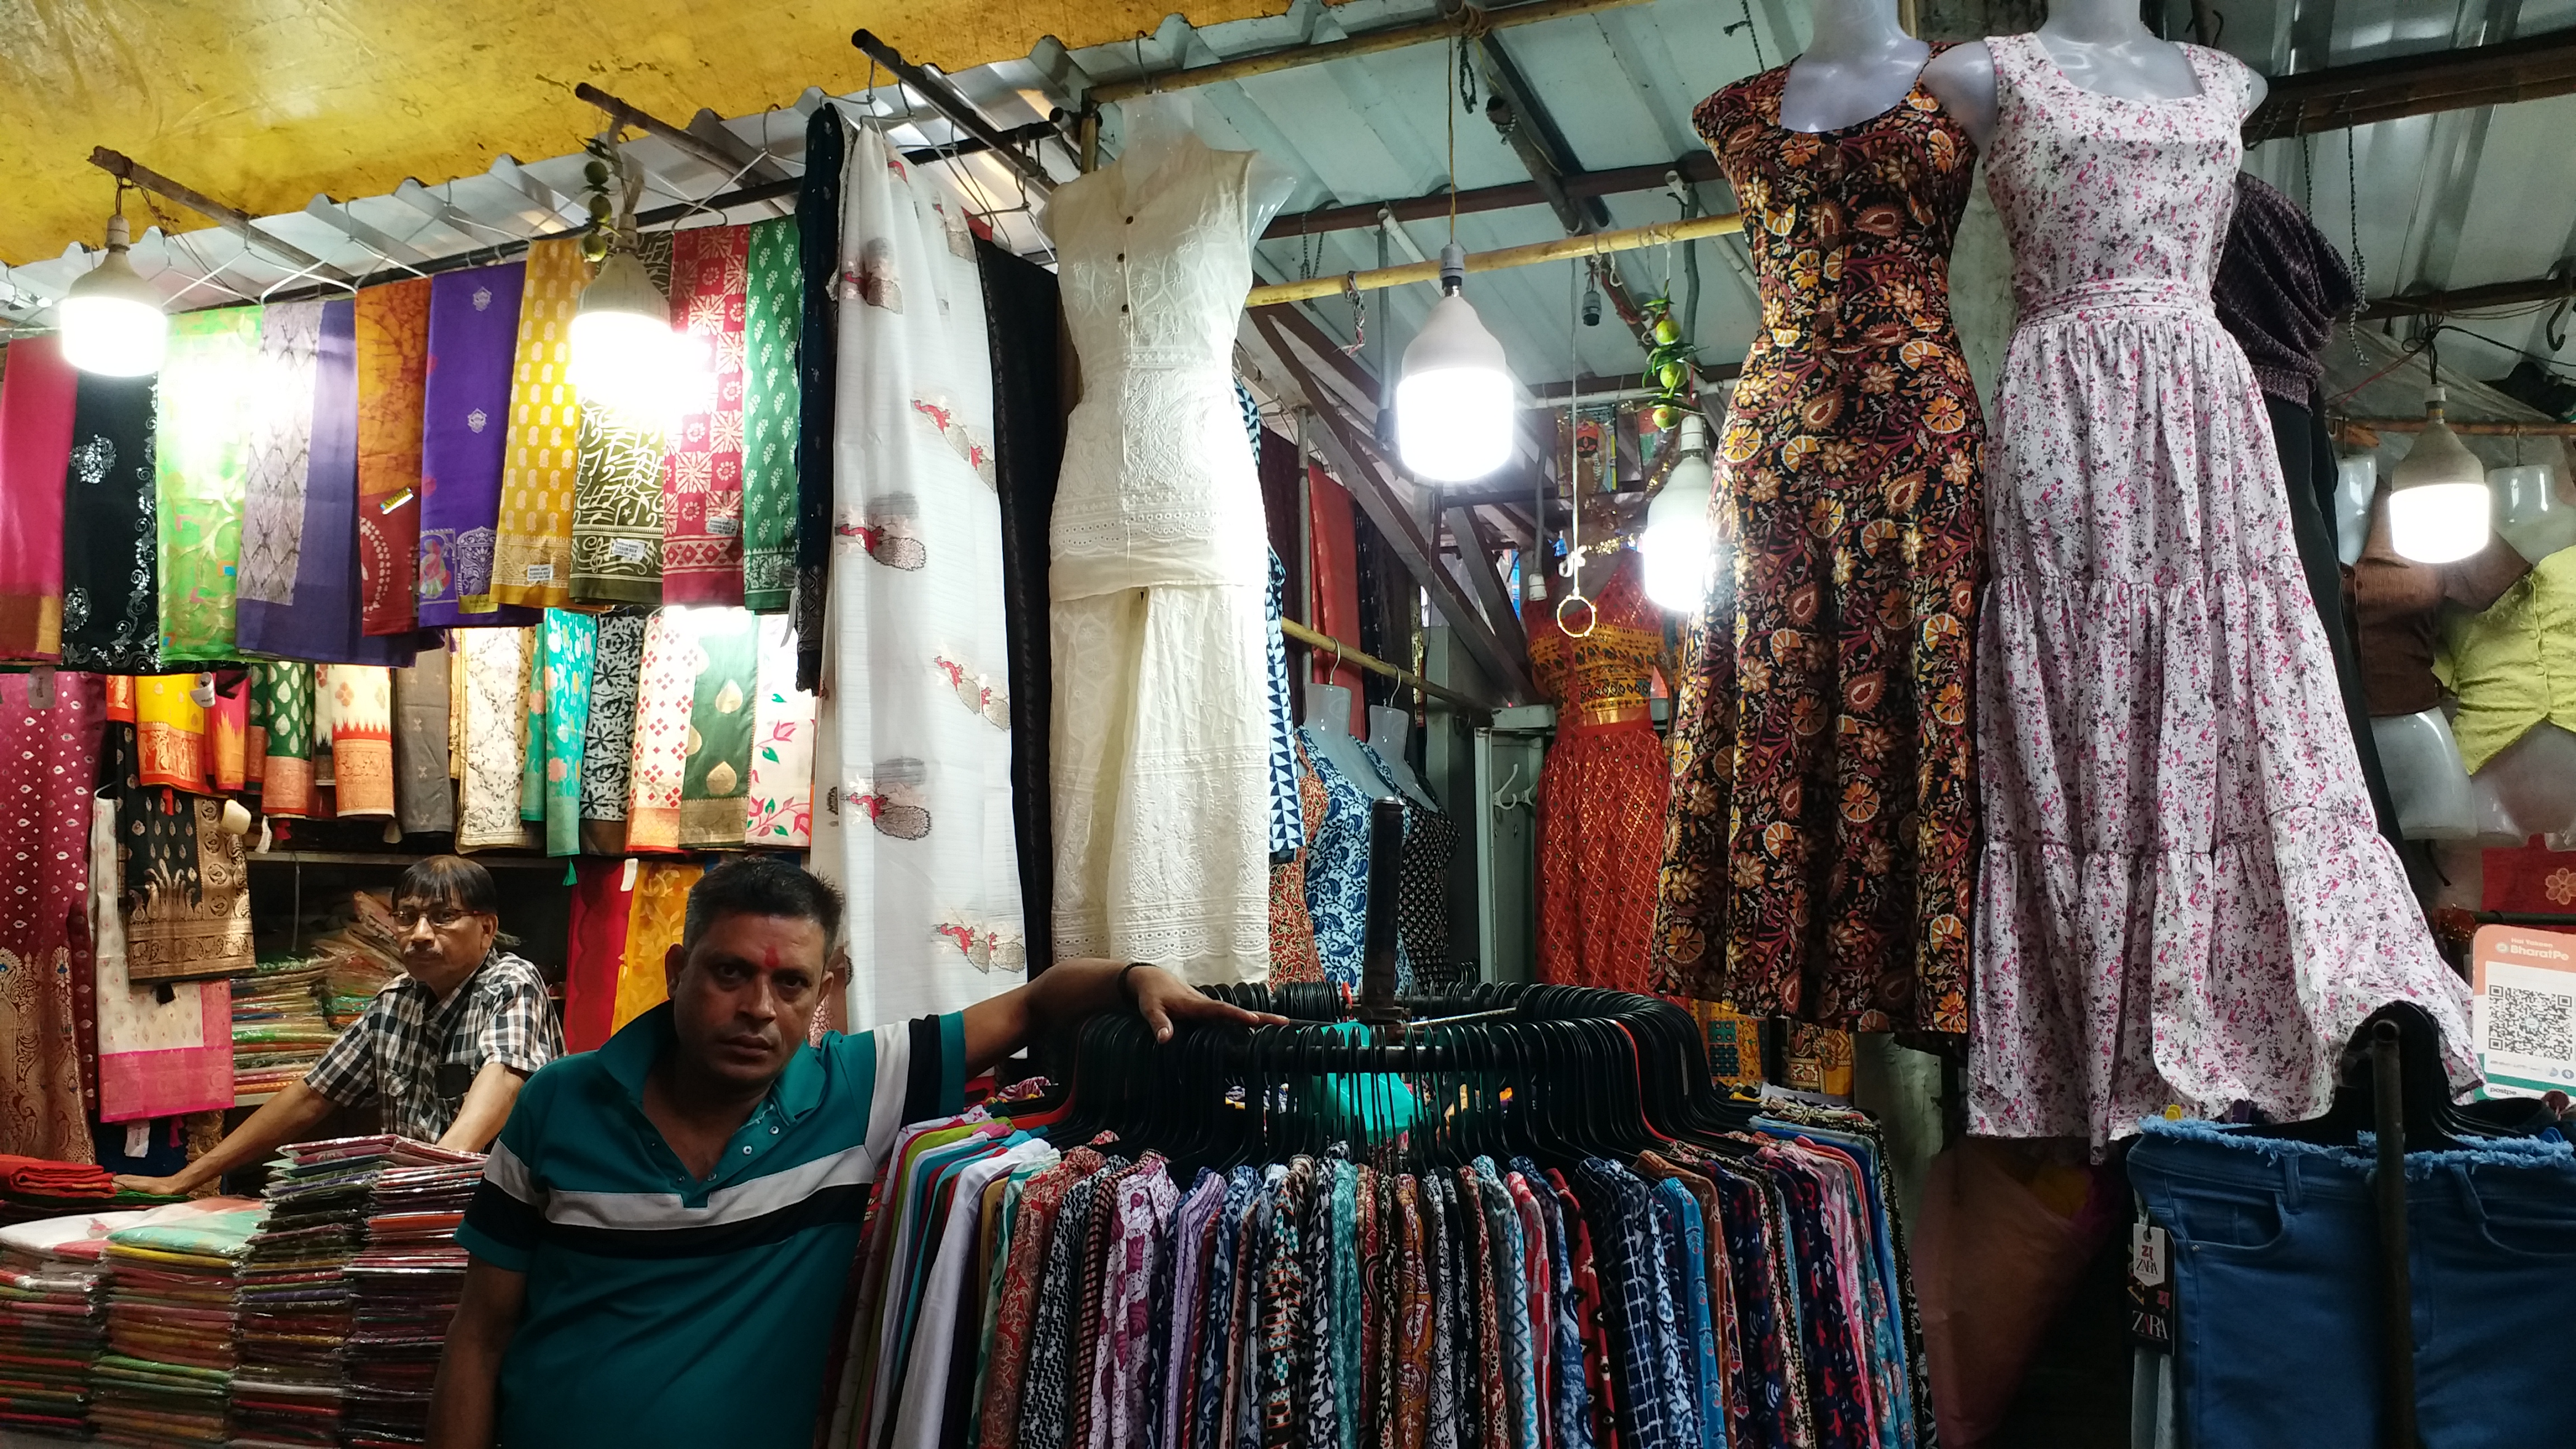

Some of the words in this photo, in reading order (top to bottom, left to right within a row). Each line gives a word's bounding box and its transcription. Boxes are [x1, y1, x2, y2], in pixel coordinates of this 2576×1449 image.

[2511, 944, 2569, 961] BharatPe
[2490, 1087, 2517, 1096] postpe
[2135, 1258, 2158, 1275] ZARA
[2132, 1310, 2169, 1340] ZARA
